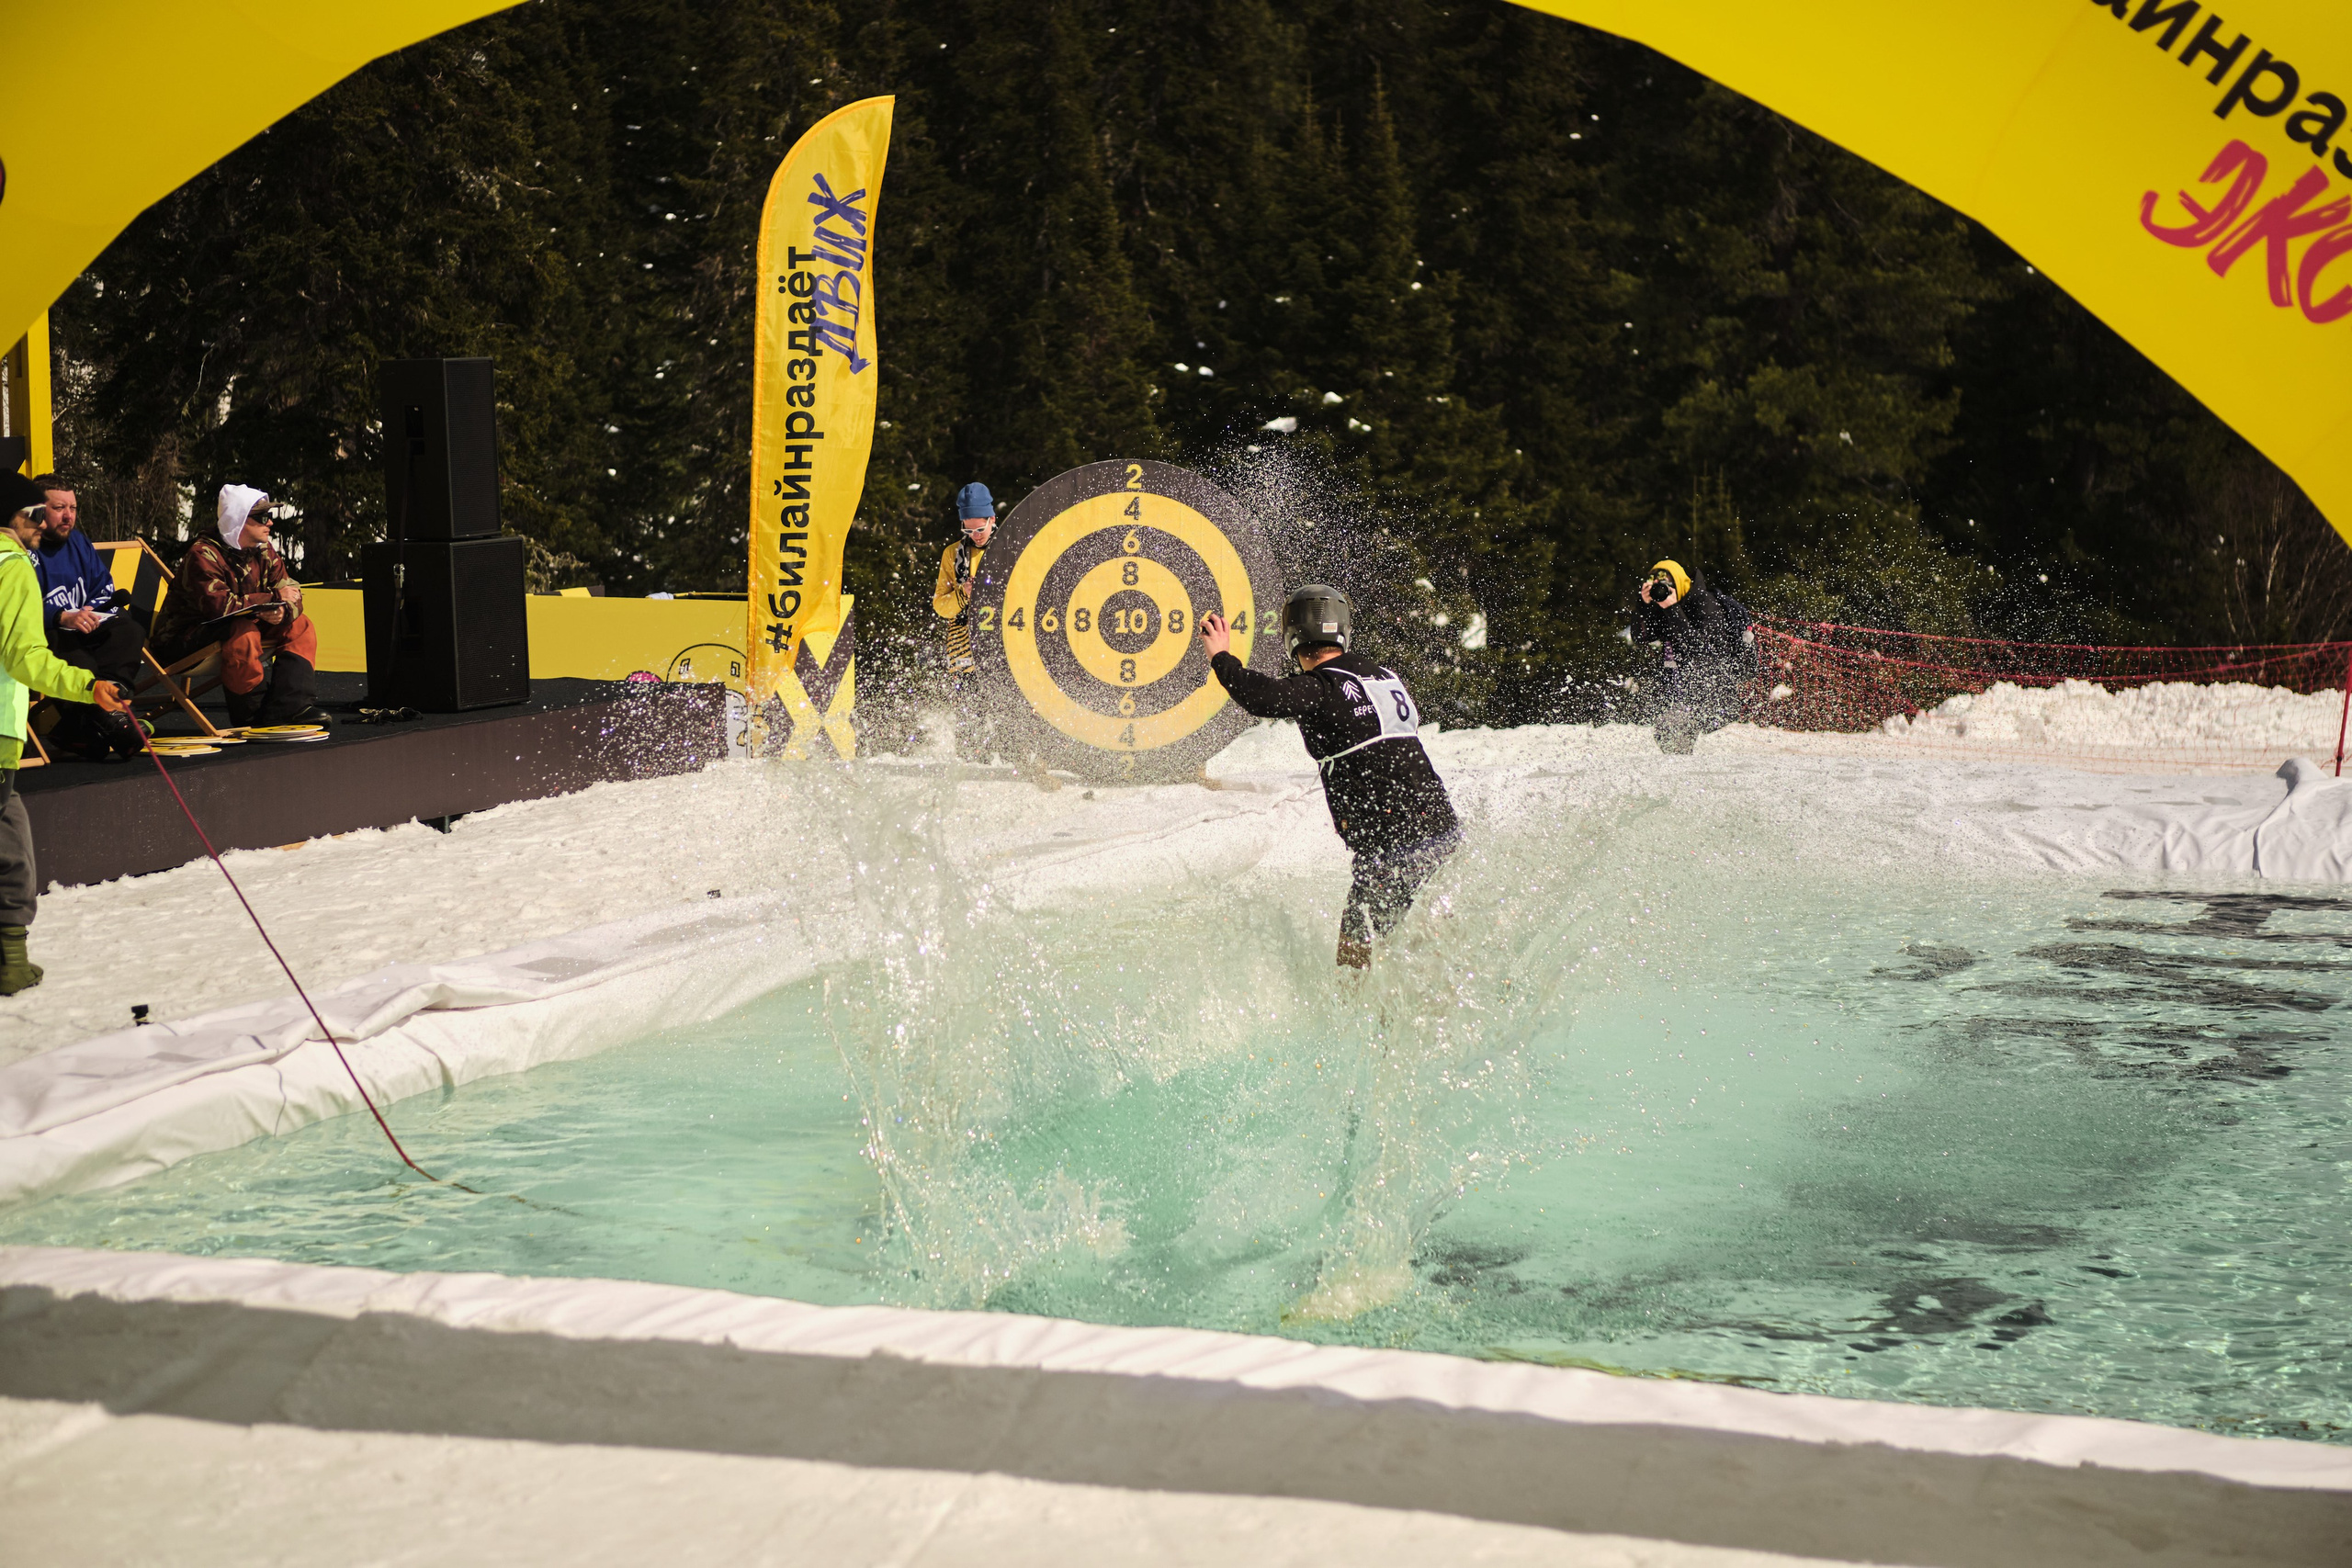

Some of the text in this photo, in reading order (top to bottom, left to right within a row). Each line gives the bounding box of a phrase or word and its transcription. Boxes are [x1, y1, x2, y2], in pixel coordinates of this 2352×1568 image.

[765, 246, 824, 654] #билайнраздаёт
[1126, 464, 1141, 489] 2
[1124, 497, 1140, 520] 4
[1123, 529, 1139, 553] 6
[1122, 561, 1139, 585] 8
[978, 606, 994, 631] 2
[1008, 607, 1025, 631] 4
[1041, 608, 1058, 632] 6
[1074, 607, 1091, 632] 8
[1114, 609, 1148, 633] 10
[1168, 610, 1184, 634] 8
[1230, 611, 1248, 634] 4
[1262, 610, 1278, 634] 2
[1120, 659, 1136, 682] 8
[1119, 692, 1136, 716] 6
[1389, 689, 1410, 722] 8
[1118, 723, 1135, 747] 4
